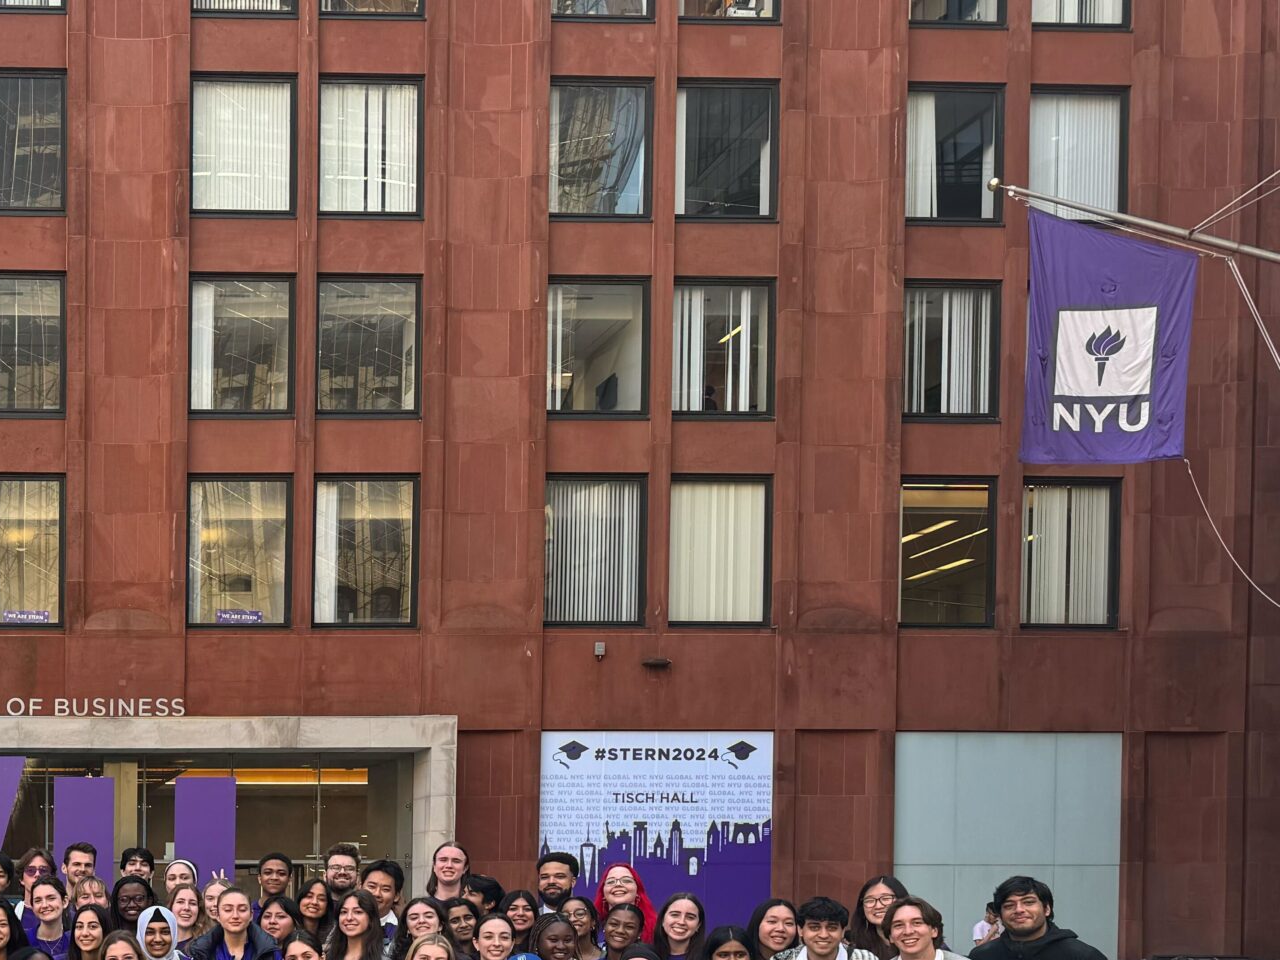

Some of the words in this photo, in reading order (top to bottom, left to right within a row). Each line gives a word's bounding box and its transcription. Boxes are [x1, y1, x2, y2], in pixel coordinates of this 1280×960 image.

[1052, 401, 1150, 433] NYU
[6, 697, 43, 717] OF
[54, 697, 185, 718] BUSINESS
[594, 747, 719, 761] #STERN2024
[612, 792, 654, 804] TISCH
[660, 793, 698, 804] HALL
